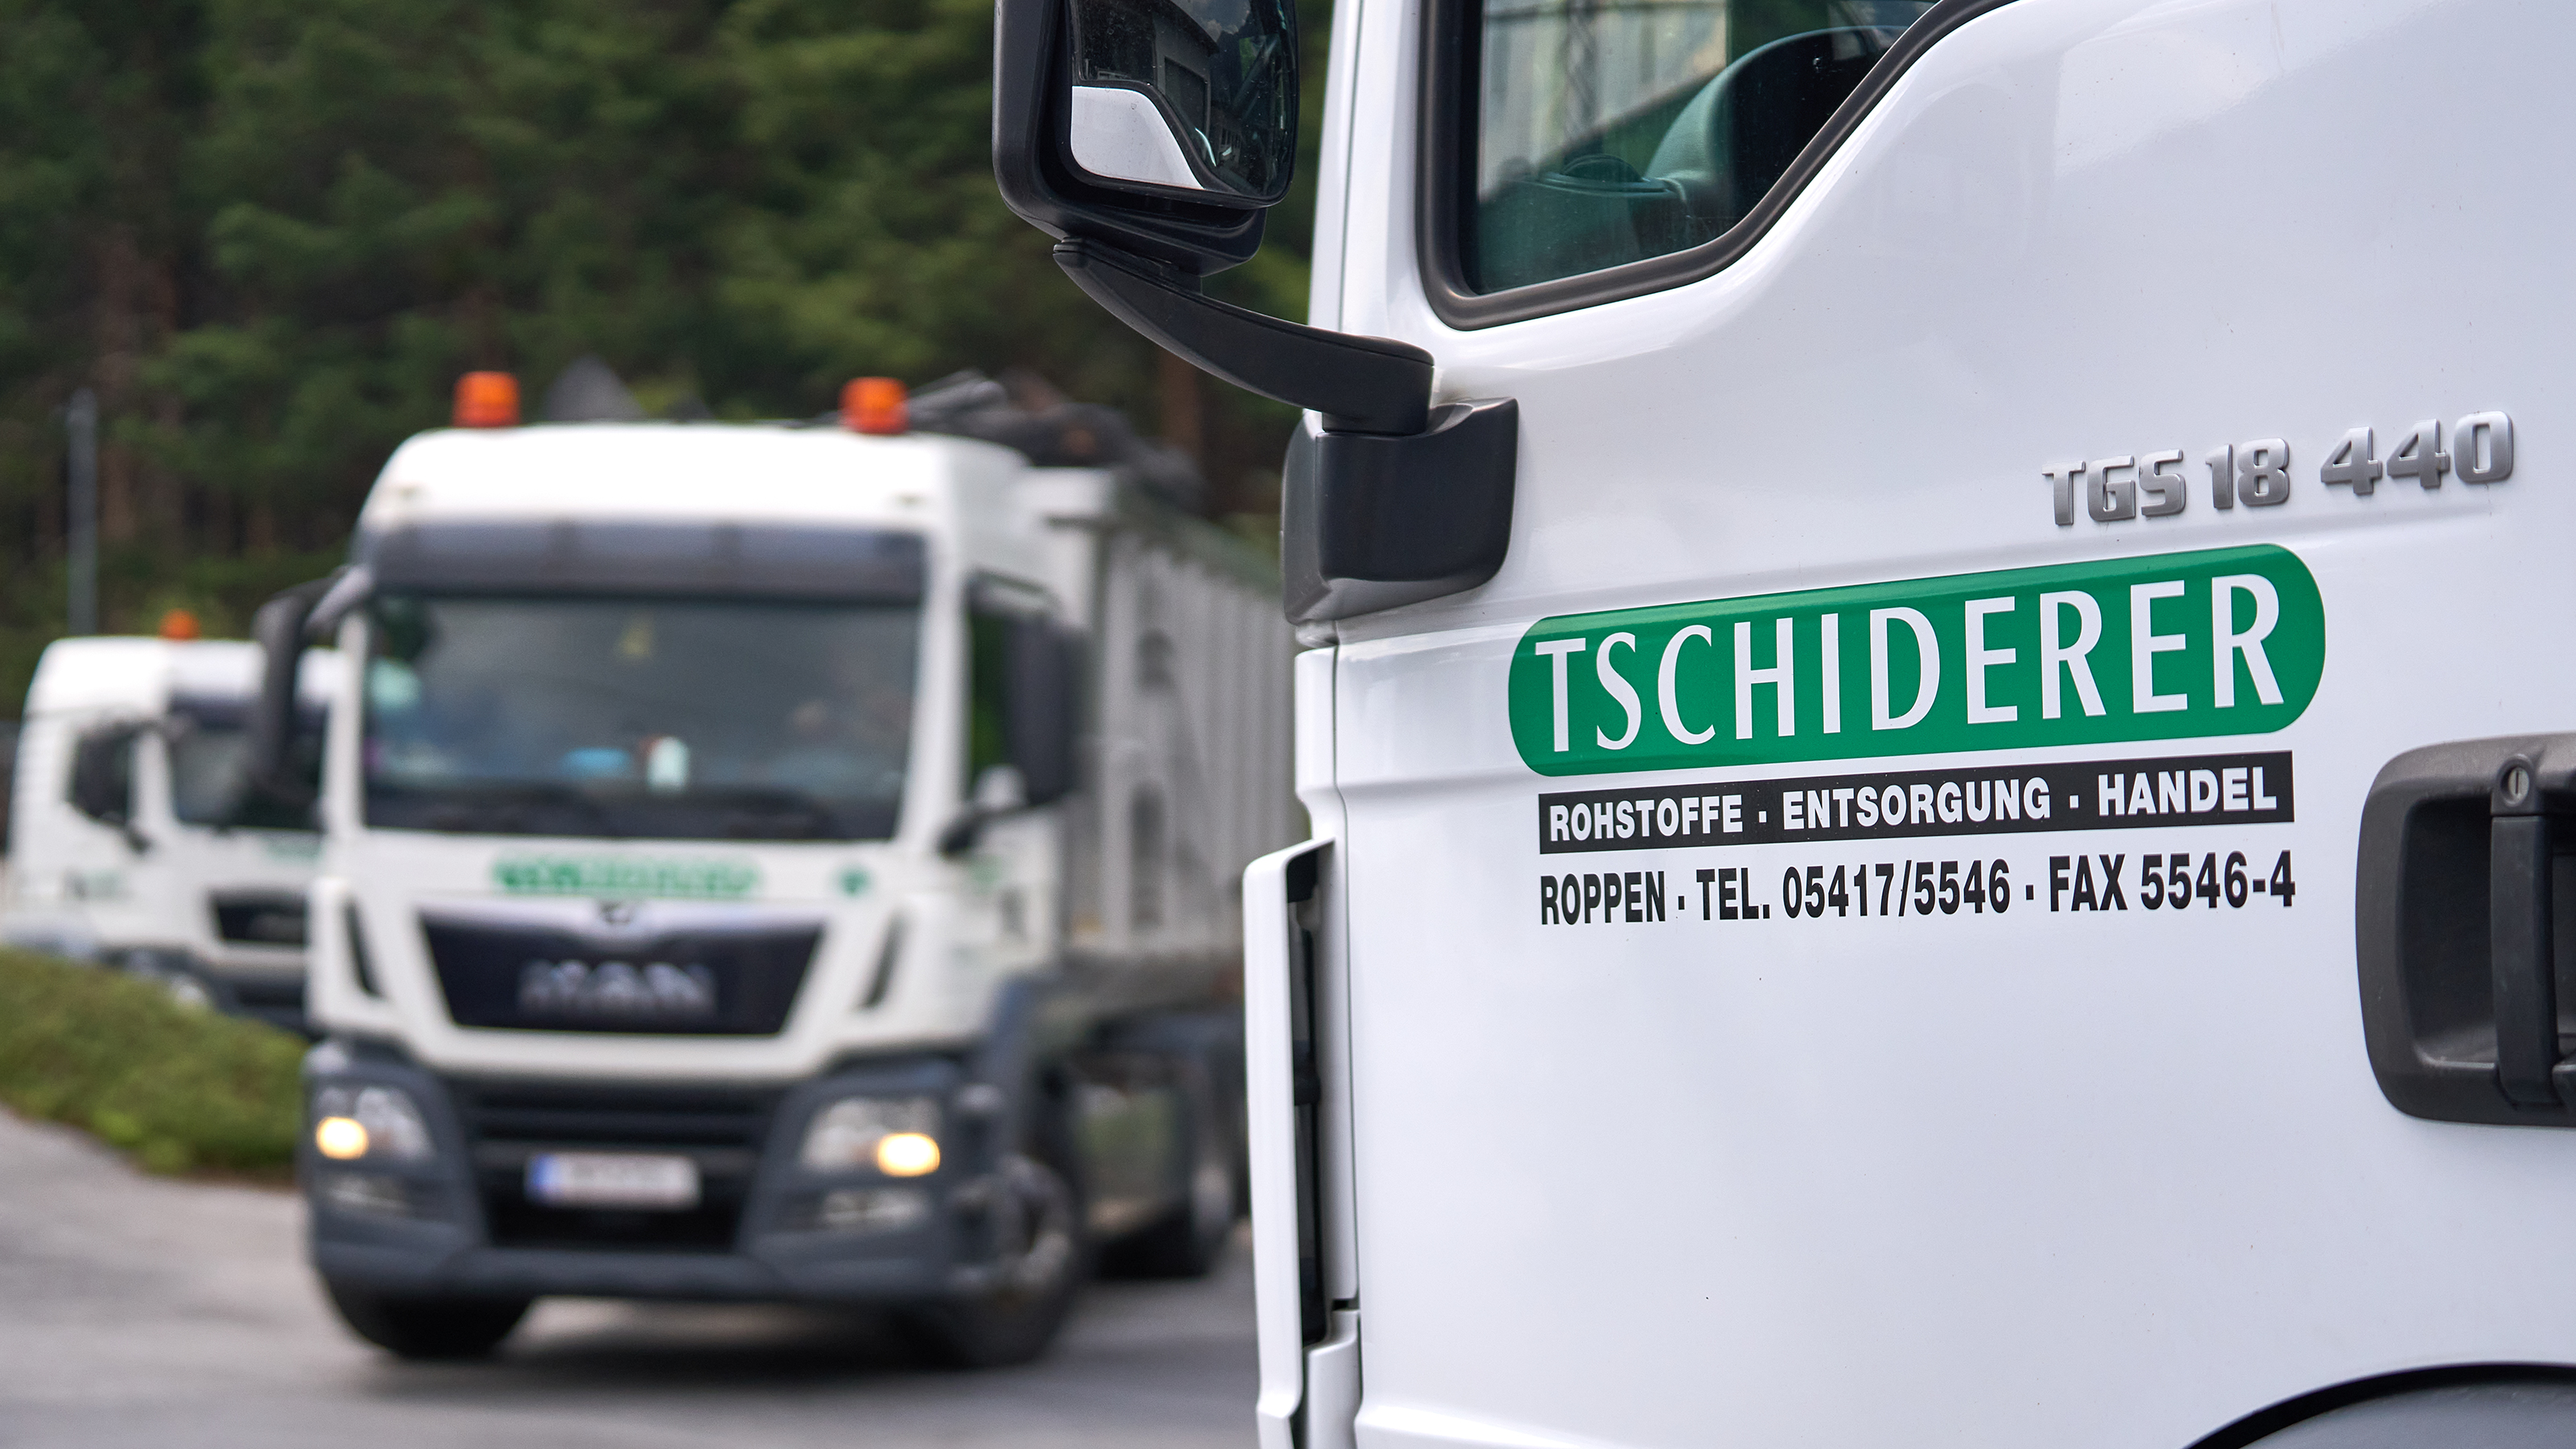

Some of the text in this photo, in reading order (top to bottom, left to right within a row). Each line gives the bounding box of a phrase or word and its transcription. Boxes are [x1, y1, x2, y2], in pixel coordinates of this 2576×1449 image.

[2041, 411, 2516, 527] TGS 18 440
[1535, 573, 2285, 753] TSCHIDERER
[1550, 766, 2277, 842] ROHSTOFFE ENTSORGUNG HANDEL
[1540, 849, 2296, 926] ROPPEN TEL. 05417/5546 FAX 5546-4
